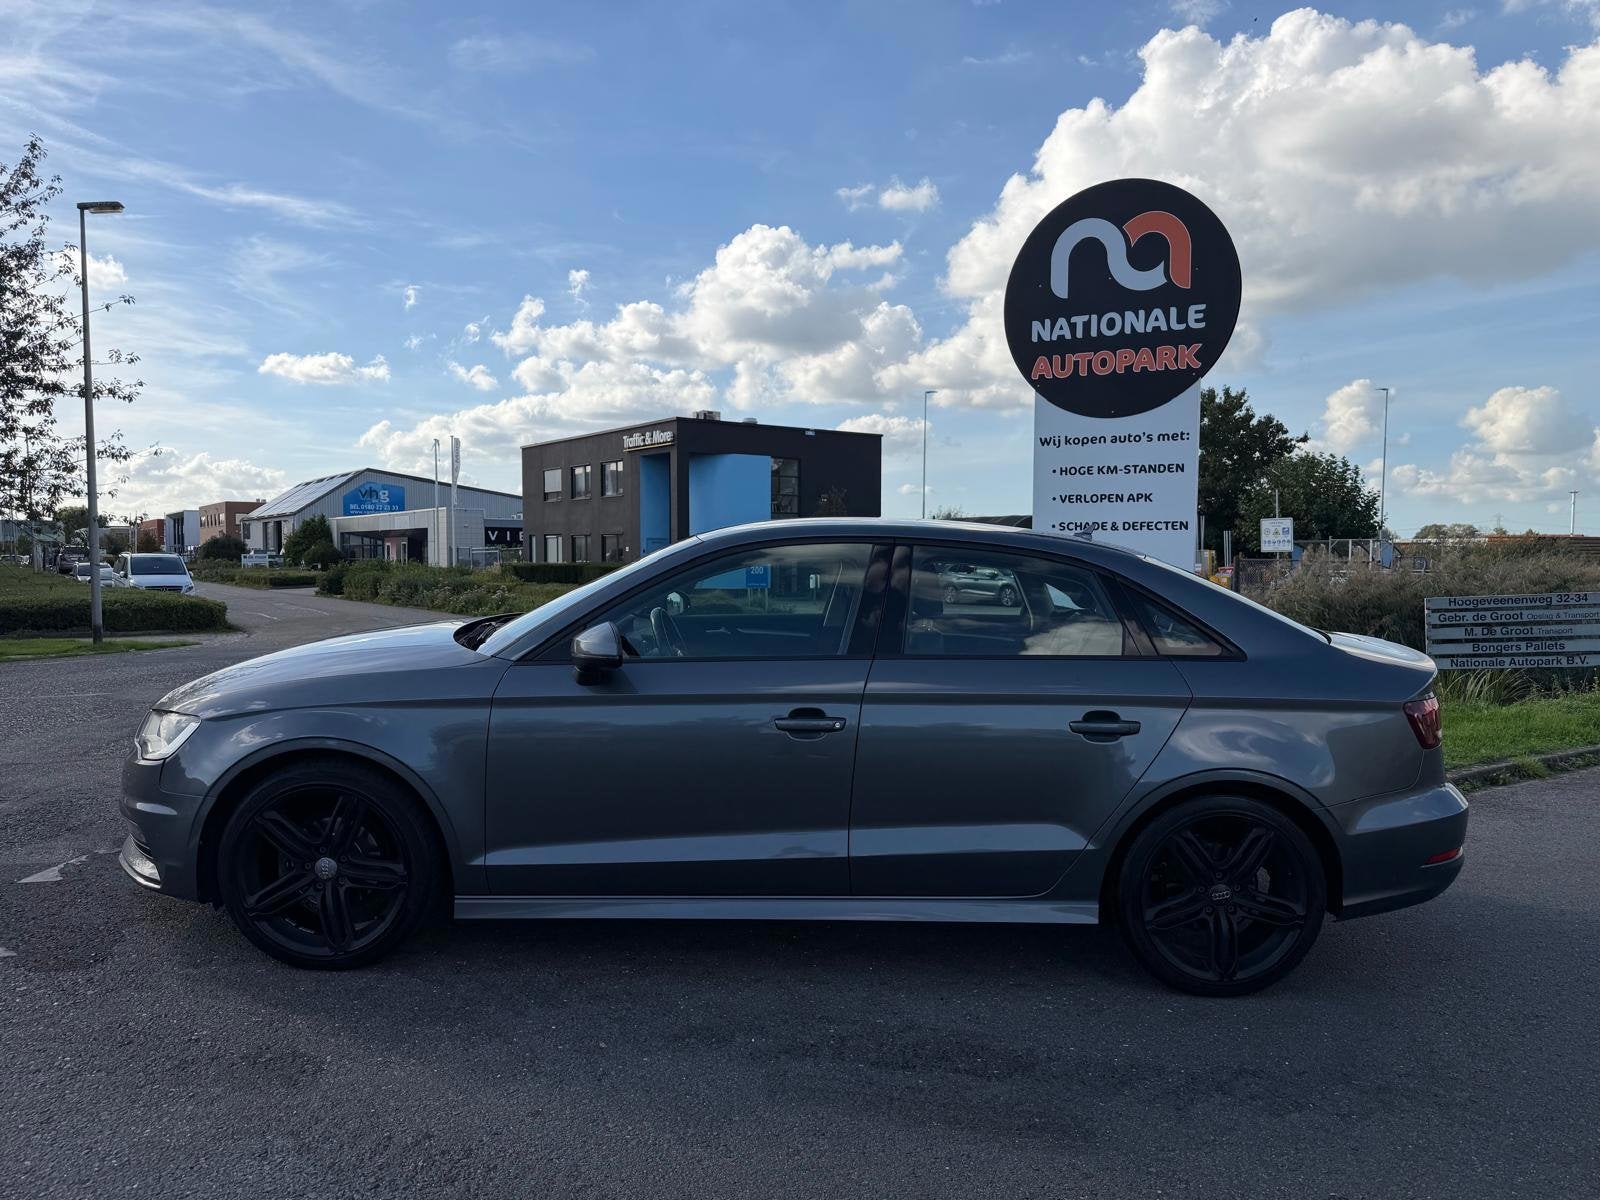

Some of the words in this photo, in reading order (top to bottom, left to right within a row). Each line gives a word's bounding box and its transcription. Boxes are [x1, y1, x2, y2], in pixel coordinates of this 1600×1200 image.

[1031, 303, 1207, 343] NATIONALE
[1031, 343, 1203, 380] AUTOPARK
[623, 433, 645, 448] Traffic
[645, 431, 651, 445] &
[1039, 436, 1061, 448] Wij
[1064, 435, 1107, 447] kopen
[1110, 432, 1153, 444] auto's
[1157, 430, 1190, 442] met:
[1059, 465, 1094, 476] HOGE
[1097, 463, 1185, 475] KM-STANDEN
[1059, 493, 1124, 504] VERLOPEN
[1127, 492, 1153, 503] APK
[1058, 521, 1108, 531] SCHADE
[1110, 521, 1119, 531] &
[1123, 520, 1189, 531] DEFECTEN
[1449, 596, 1552, 608] Hoogeveenenweg
[1556, 593, 1588, 603] 32-34
[1438, 613, 1468, 622] Gebr.
[1472, 612, 1486, 621] de
[1490, 611, 1523, 620] Groot
[1464, 627, 1478, 637] M.
[1481, 627, 1497, 636] De
[1500, 626, 1534, 636] Groot
[1472, 643, 1521, 653] Bongers
[1525, 642, 1565, 651] Pallets
[1450, 658, 1505, 668] Nationale
[1508, 656, 1562, 668] Autopark
[1566, 655, 1589, 665] B.V.
